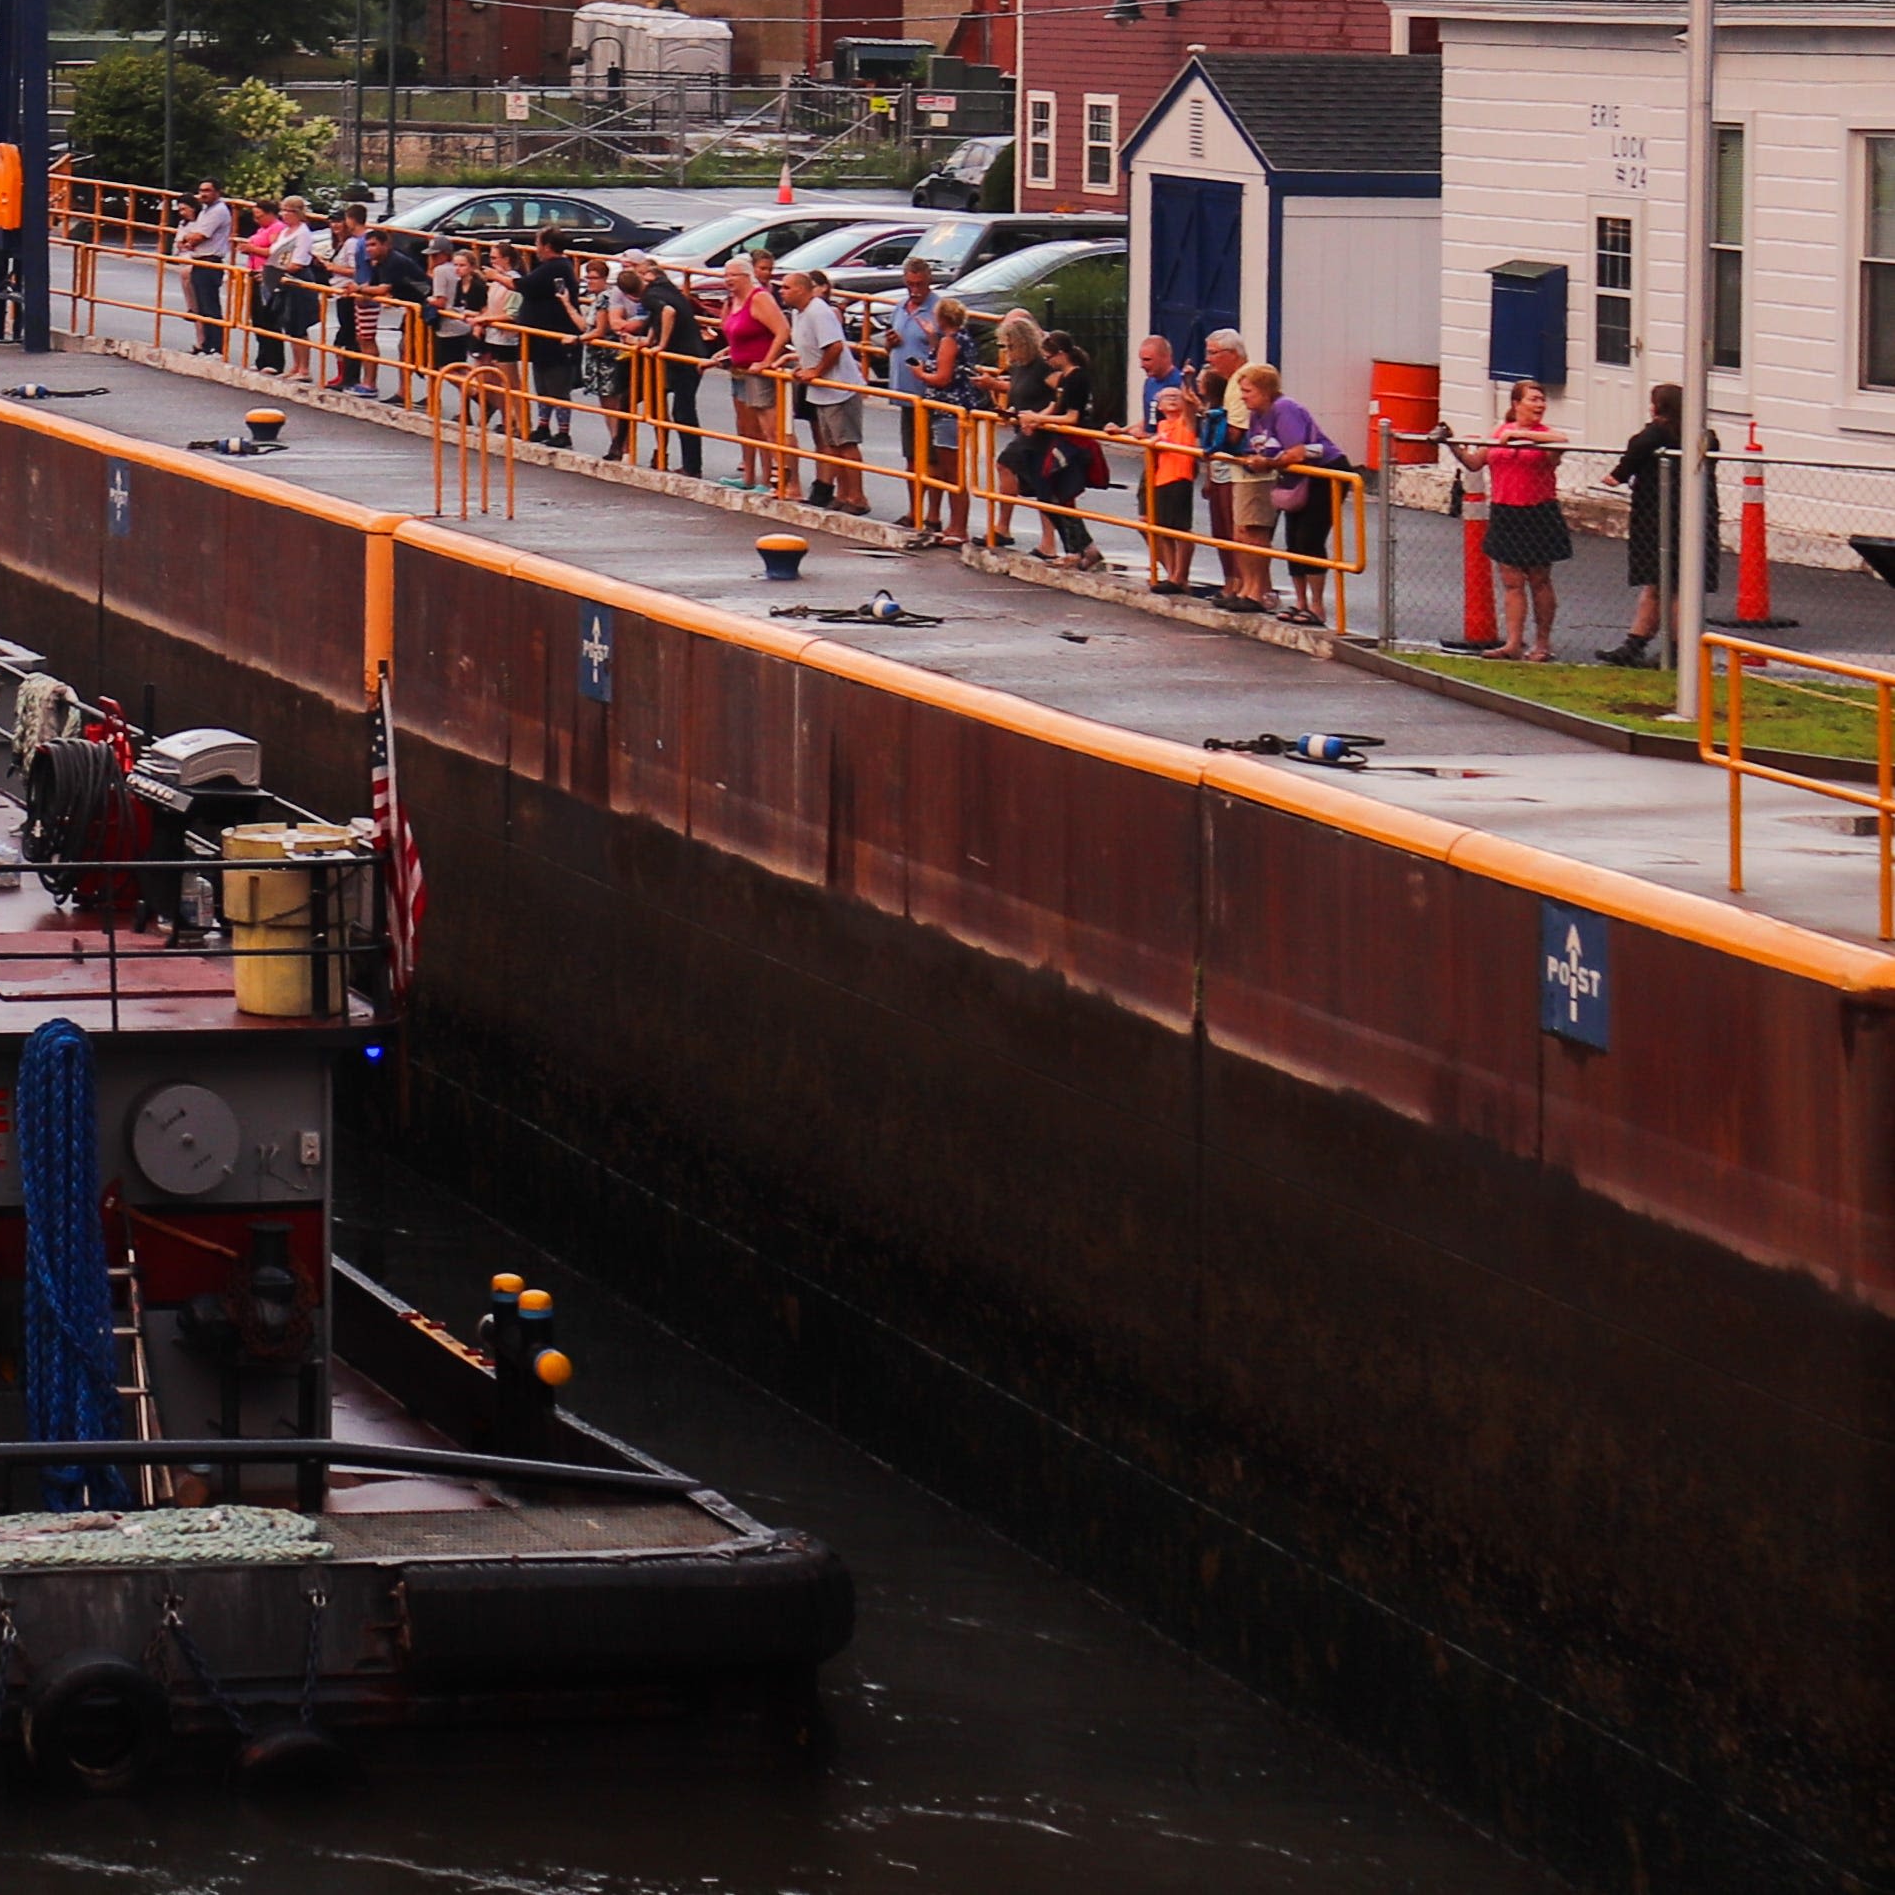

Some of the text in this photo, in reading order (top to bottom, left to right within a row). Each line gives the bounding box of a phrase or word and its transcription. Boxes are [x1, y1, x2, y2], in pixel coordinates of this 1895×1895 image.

[1592, 104, 1621, 127] ERIE
[1612, 135, 1647, 160] LOCK
[1615, 163, 1646, 189] #24
[1546, 955, 1602, 998] POST
